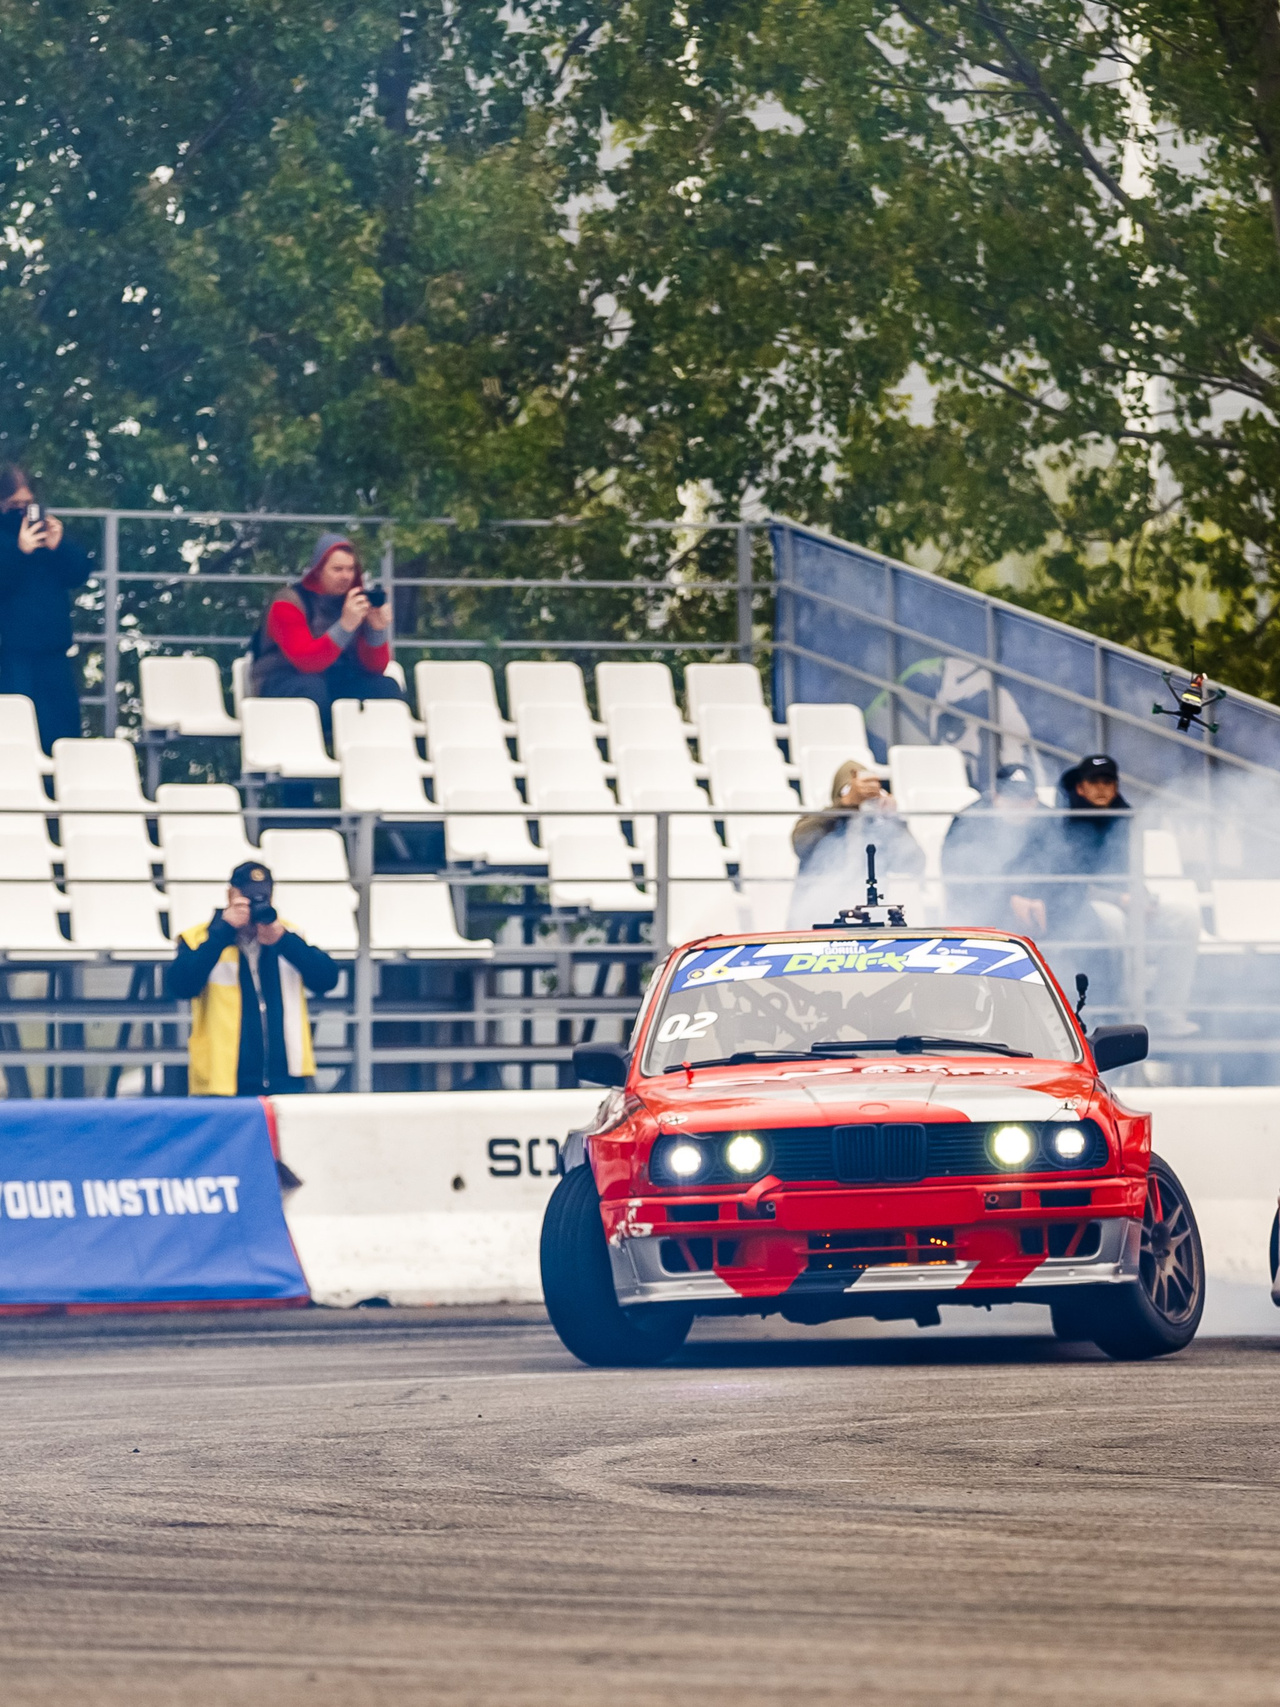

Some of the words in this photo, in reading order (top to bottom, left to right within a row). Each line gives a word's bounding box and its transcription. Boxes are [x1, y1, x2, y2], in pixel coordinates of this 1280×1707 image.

[657, 1011, 719, 1043] 02
[0, 1180, 76, 1219] OUR
[82, 1176, 240, 1217] INSTINCT
